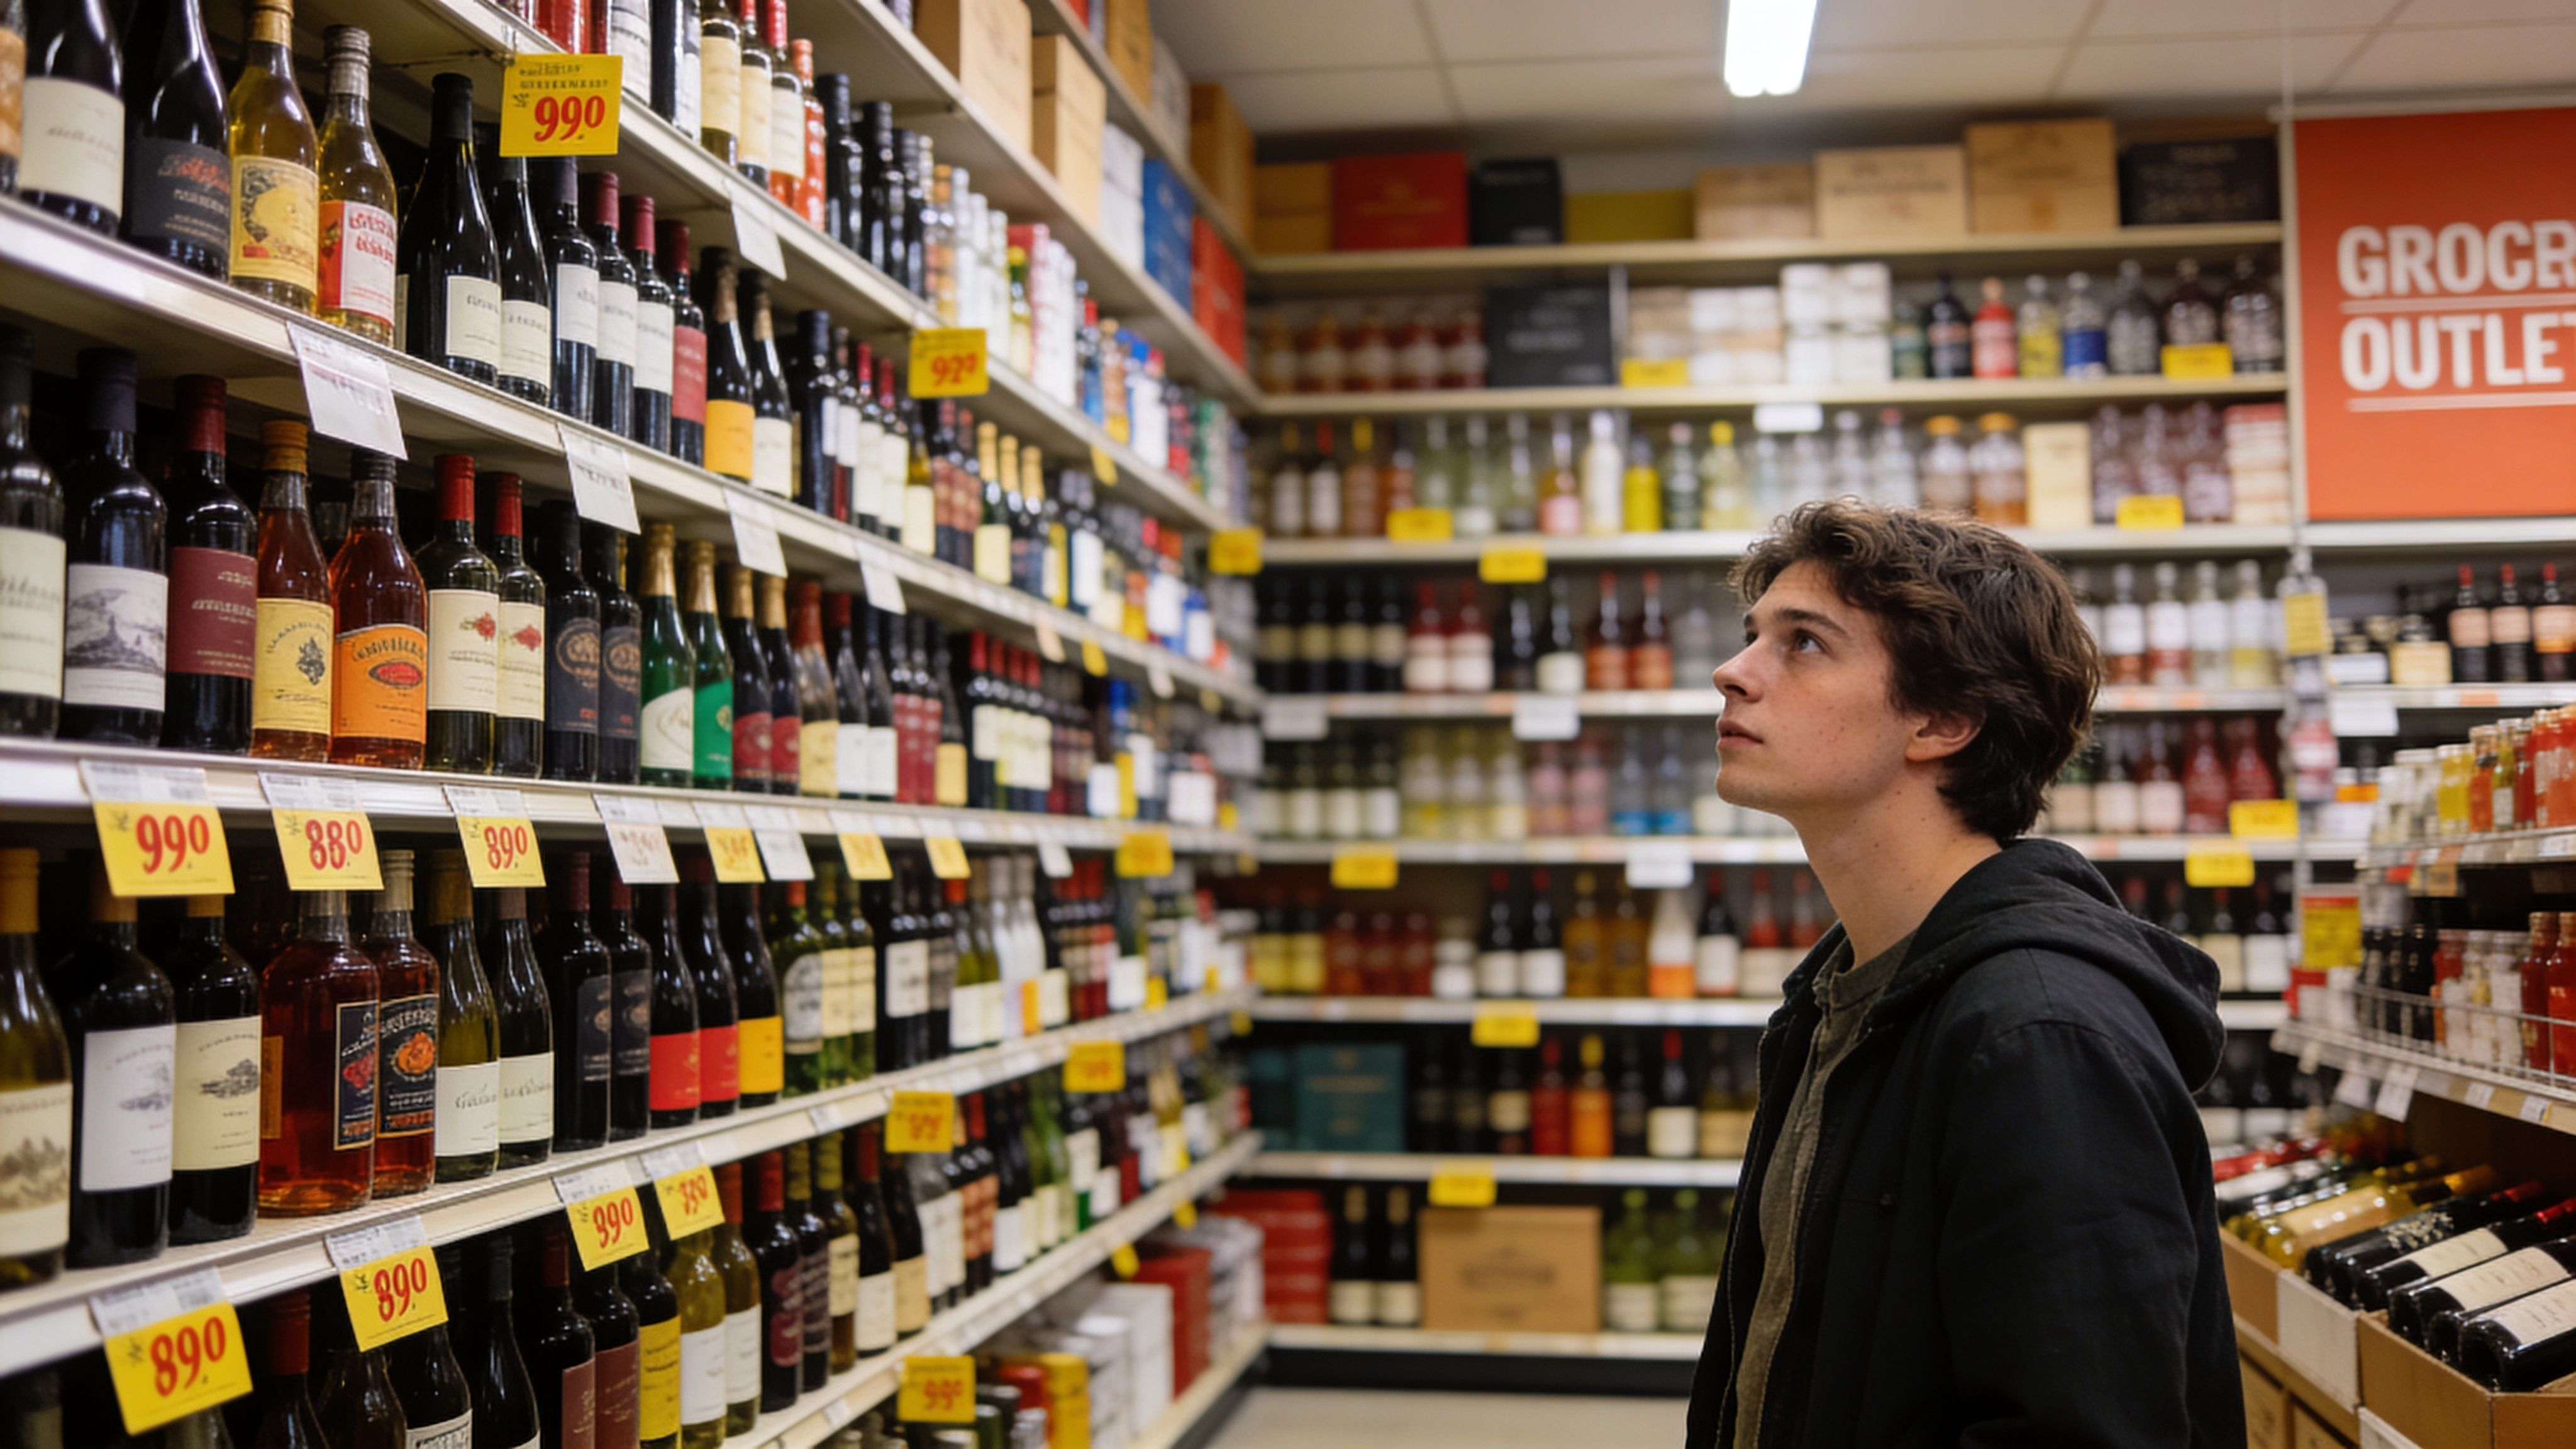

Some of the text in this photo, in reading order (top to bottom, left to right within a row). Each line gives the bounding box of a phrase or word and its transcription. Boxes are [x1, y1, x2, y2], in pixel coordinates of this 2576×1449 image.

[534, 96, 606, 142] 990
[136, 814, 209, 874] 990
[305, 819, 362, 870] 880
[484, 826, 527, 869] 890
[374, 1258, 427, 1323] 890
[150, 1316, 226, 1397] 890
